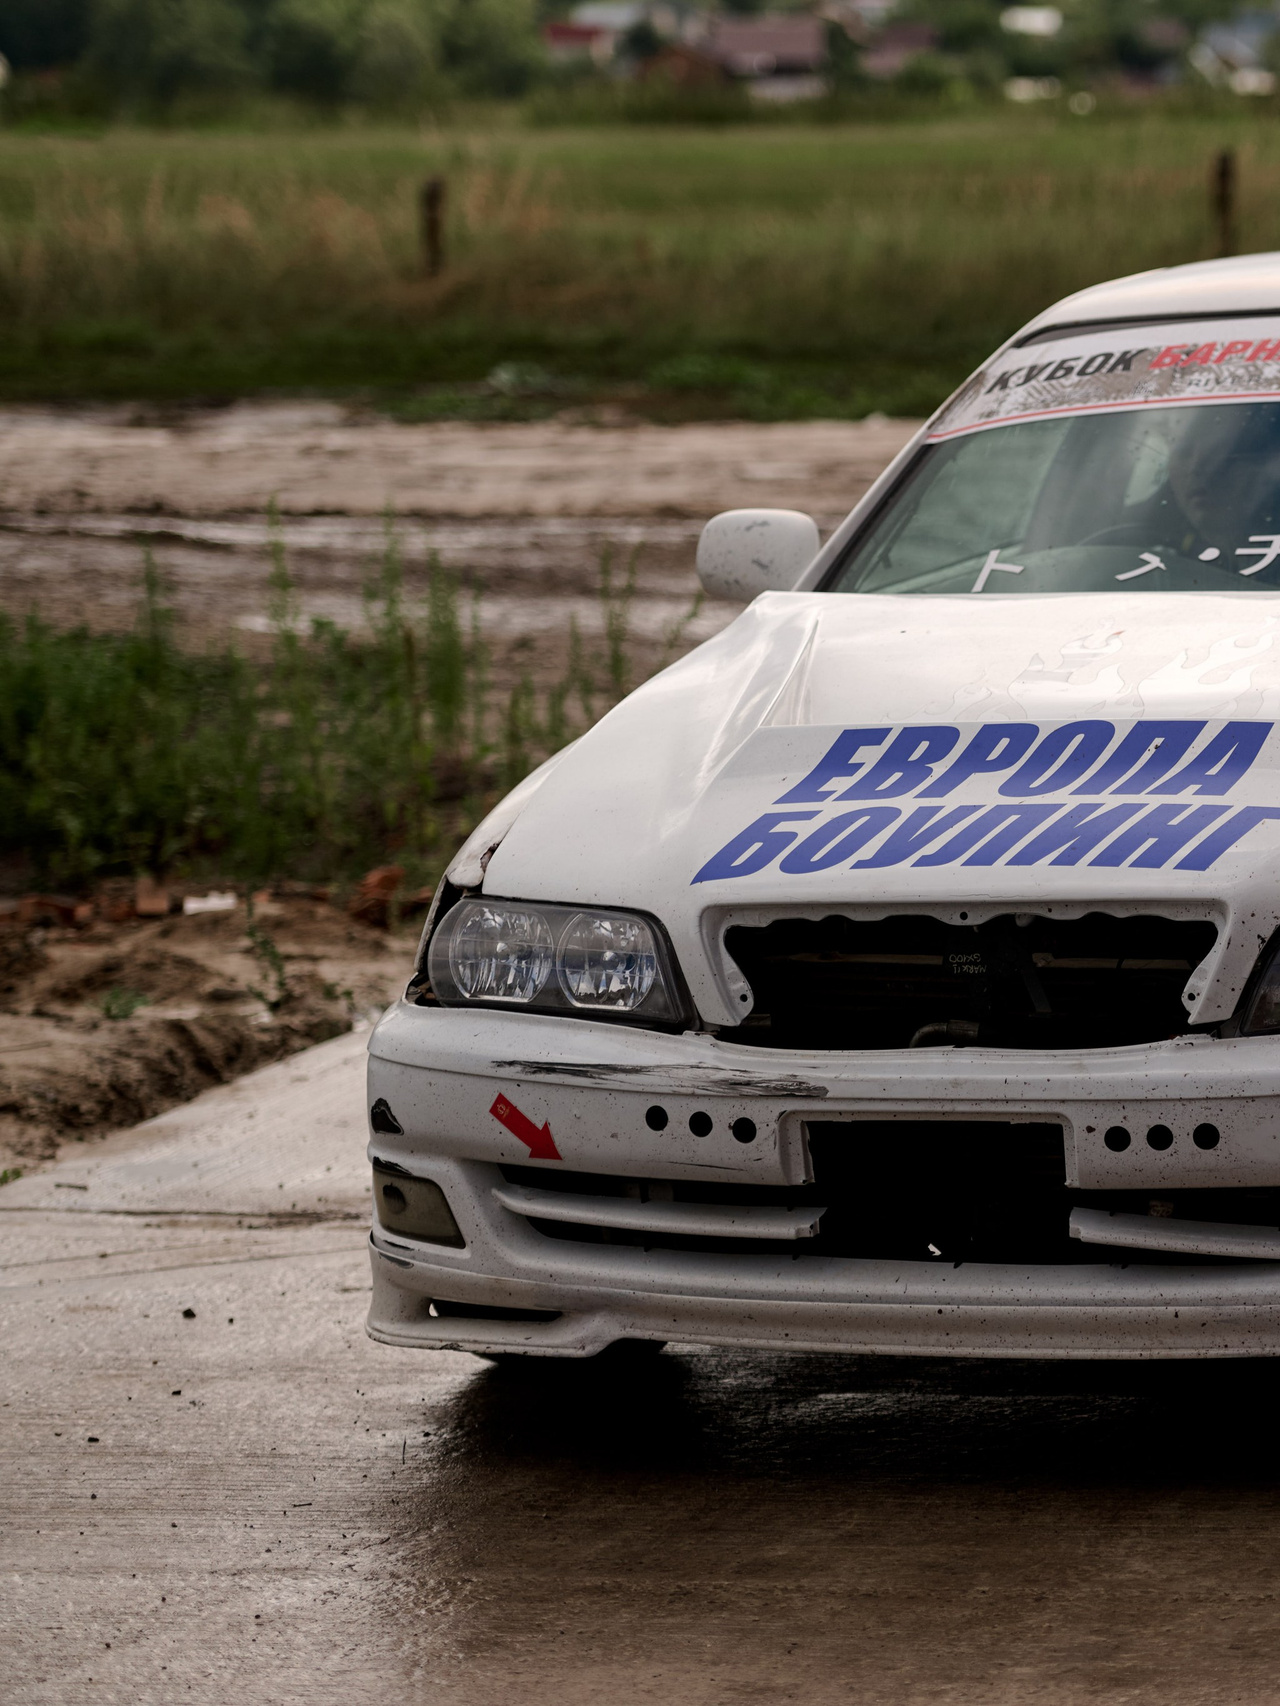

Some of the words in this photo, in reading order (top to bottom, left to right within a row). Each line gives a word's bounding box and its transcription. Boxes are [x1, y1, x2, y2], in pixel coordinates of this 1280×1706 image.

[984, 349, 1149, 394] КУБОК
[771, 719, 1275, 805] ЕВРОПА
[948, 953, 982, 963] GX100
